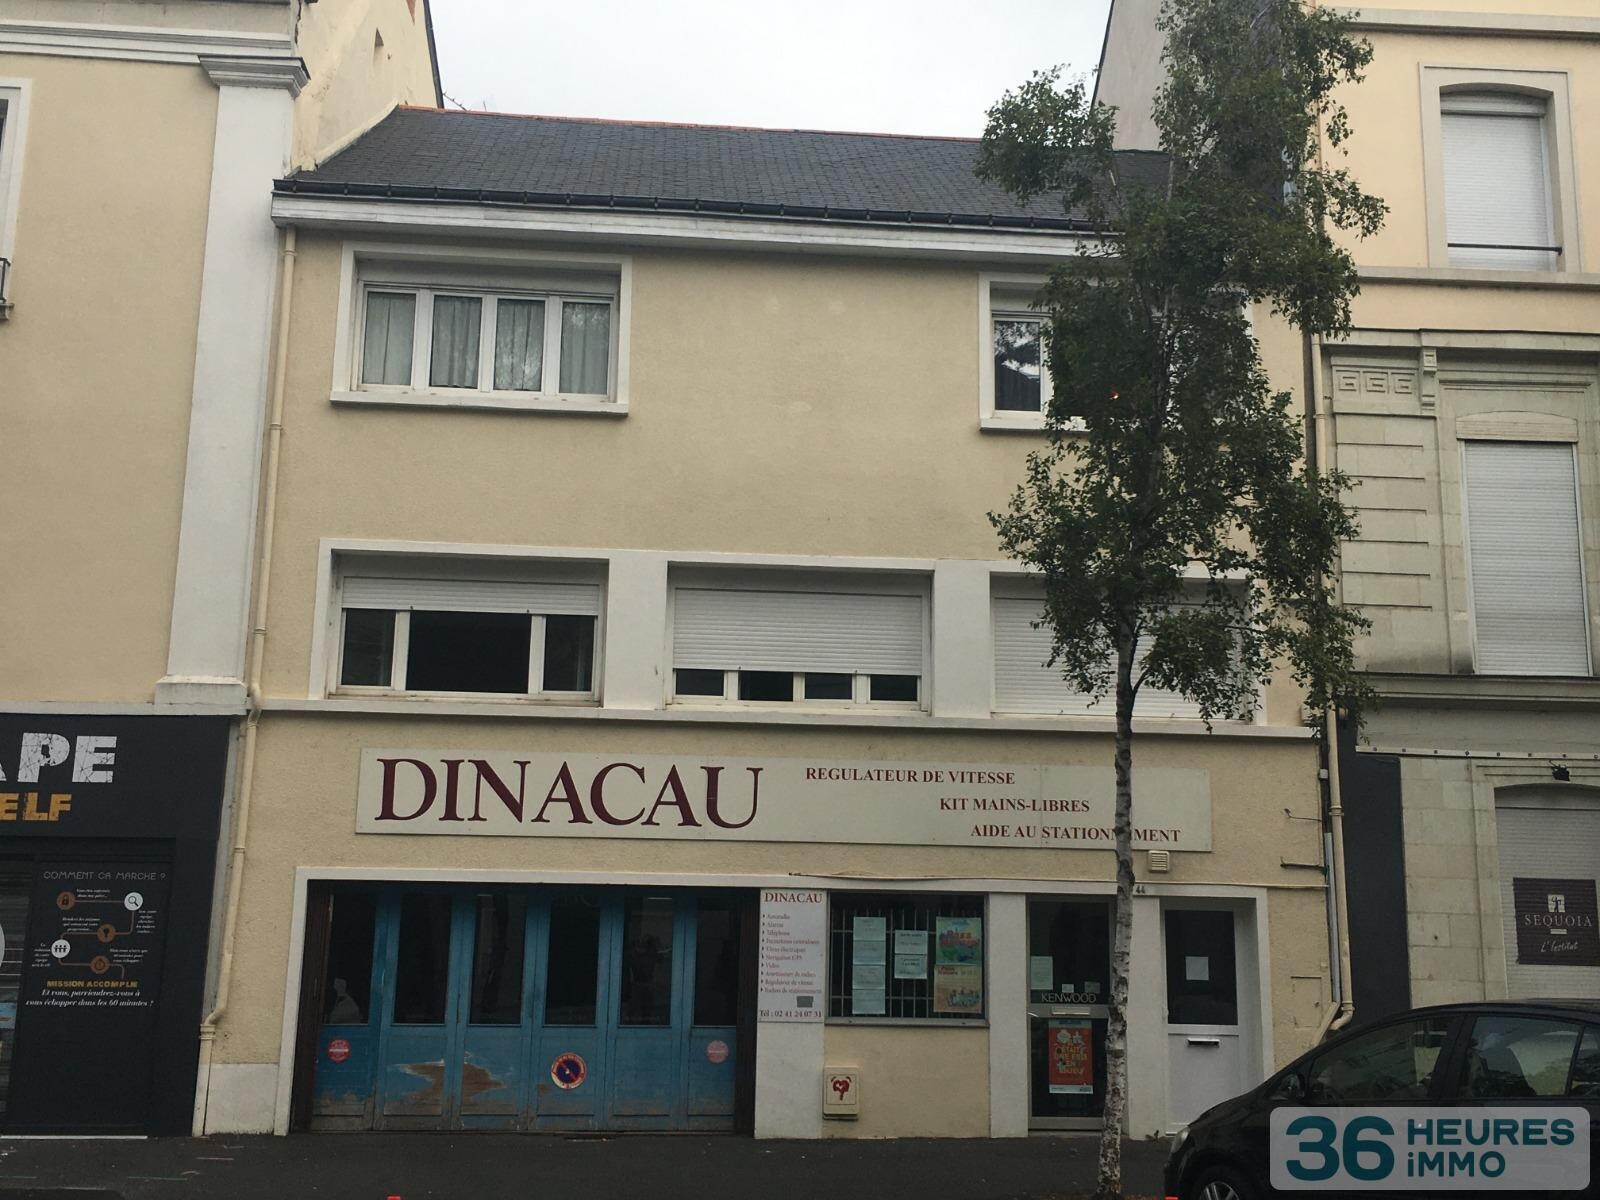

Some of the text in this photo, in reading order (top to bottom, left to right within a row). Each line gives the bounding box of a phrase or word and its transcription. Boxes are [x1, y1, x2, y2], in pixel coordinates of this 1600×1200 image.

[0, 732, 118, 783] PE
[806, 767, 1016, 784] REGULATEUR DE VITESSE
[374, 758, 764, 829] DINACAU
[940, 798, 1090, 812] KIT MAINS-LIBRES
[970, 824, 1181, 842] AIDE AU STATIONMENT
[44, 872, 94, 880] COMMENT
[765, 892, 822, 903] DINACAU
[1524, 914, 1592, 927] SEQUOIA
[1041, 992, 1096, 1003] KENWOOD
